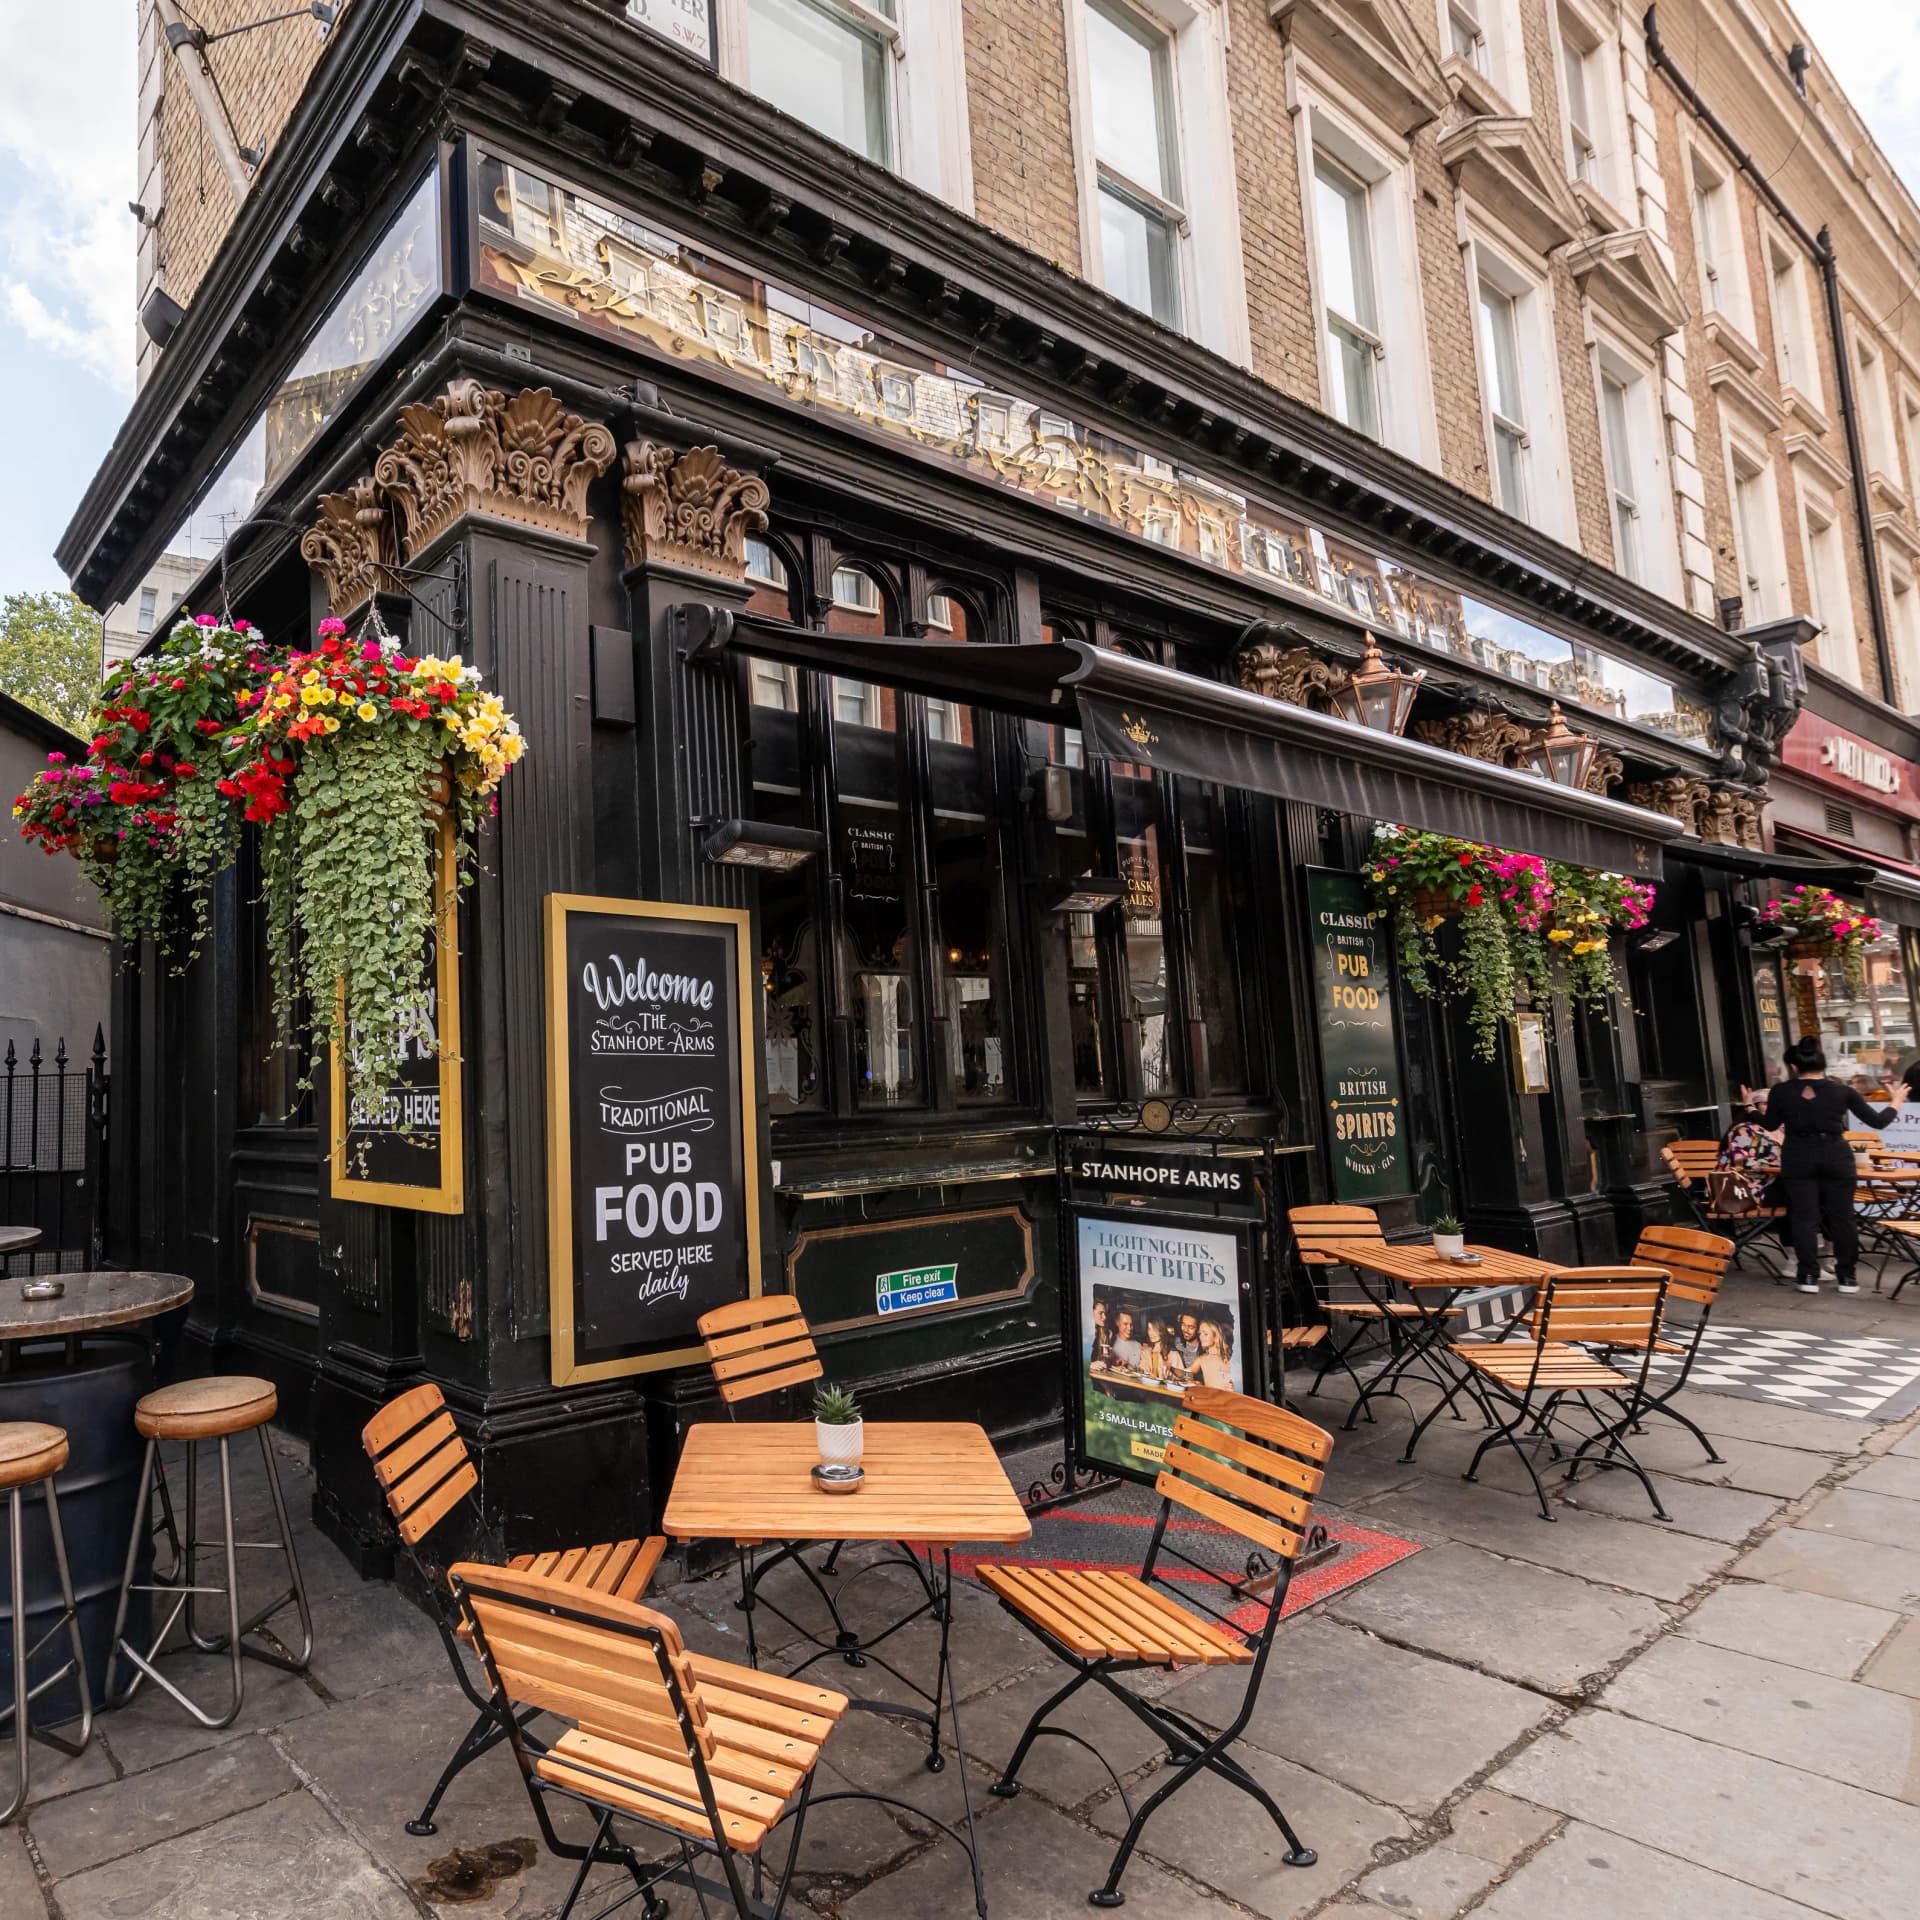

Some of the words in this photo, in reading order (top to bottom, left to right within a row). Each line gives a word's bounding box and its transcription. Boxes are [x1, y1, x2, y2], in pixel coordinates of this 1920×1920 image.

[847, 827, 895, 841] CLASSIC
[1127, 878, 1153, 893] CASK
[1129, 894, 1154, 907] ALES
[1320, 911, 1375, 930] CLASSIC
[1337, 935, 1364, 947] BRITISH
[1337, 953, 1369, 977] PUB
[583, 954, 714, 1011] Welcome
[1332, 985, 1379, 1010] FOOD
[639, 1013, 668, 1031] THE
[591, 1030, 665, 1051] STANHOPE
[667, 1032, 715, 1053] ARMS
[1339, 1081, 1387, 1096] BRITISH
[404, 1094, 440, 1125] HERE
[600, 1094, 710, 1127] TRADITIONAL
[1335, 1112, 1396, 1140] SPIRITS
[625, 1141, 692, 1176] PUB
[1345, 1156, 1377, 1175] WHISKY
[1382, 1154, 1396, 1170] GIN
[1081, 1162, 1180, 1185] STANHOPE
[1185, 1170, 1241, 1190] ARMS
[595, 1181, 723, 1241] FOOD
[1100, 1232, 1149, 1251] LIGHT
[1149, 1238, 1215, 1261] NIGHTS,
[610, 1249, 673, 1274] SERVED
[677, 1244, 713, 1266] HERE
[1091, 1248, 1158, 1275] LIGHT
[1161, 1257, 1226, 1287] BITES
[638, 1265, 689, 1301] daily
[902, 1274, 921, 1287] Fire
[923, 1270, 941, 1282] exit
[900, 1291, 922, 1304] Keep
[924, 1287, 944, 1298] clear
[1106, 1413, 1138, 1427] SMALL
[1138, 1421, 1174, 1437] PLATES
[1143, 1447, 1164, 1458] MADE
